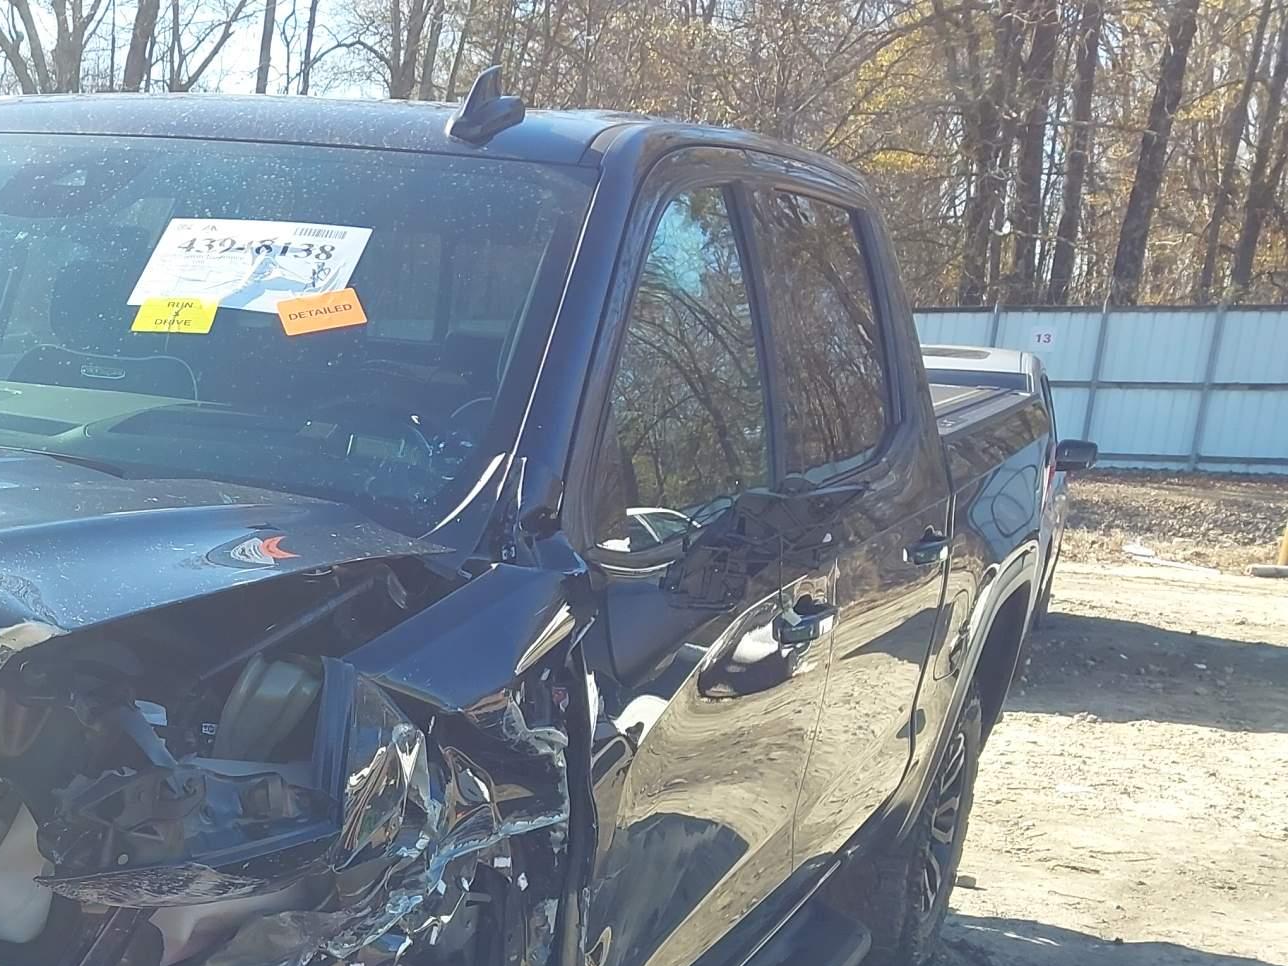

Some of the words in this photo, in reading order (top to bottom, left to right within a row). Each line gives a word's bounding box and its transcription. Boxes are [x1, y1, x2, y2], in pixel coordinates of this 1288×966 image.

[167, 301, 194, 309] RUN
[288, 303, 353, 321] DETAILED
[1036, 333, 1052, 344] 13
